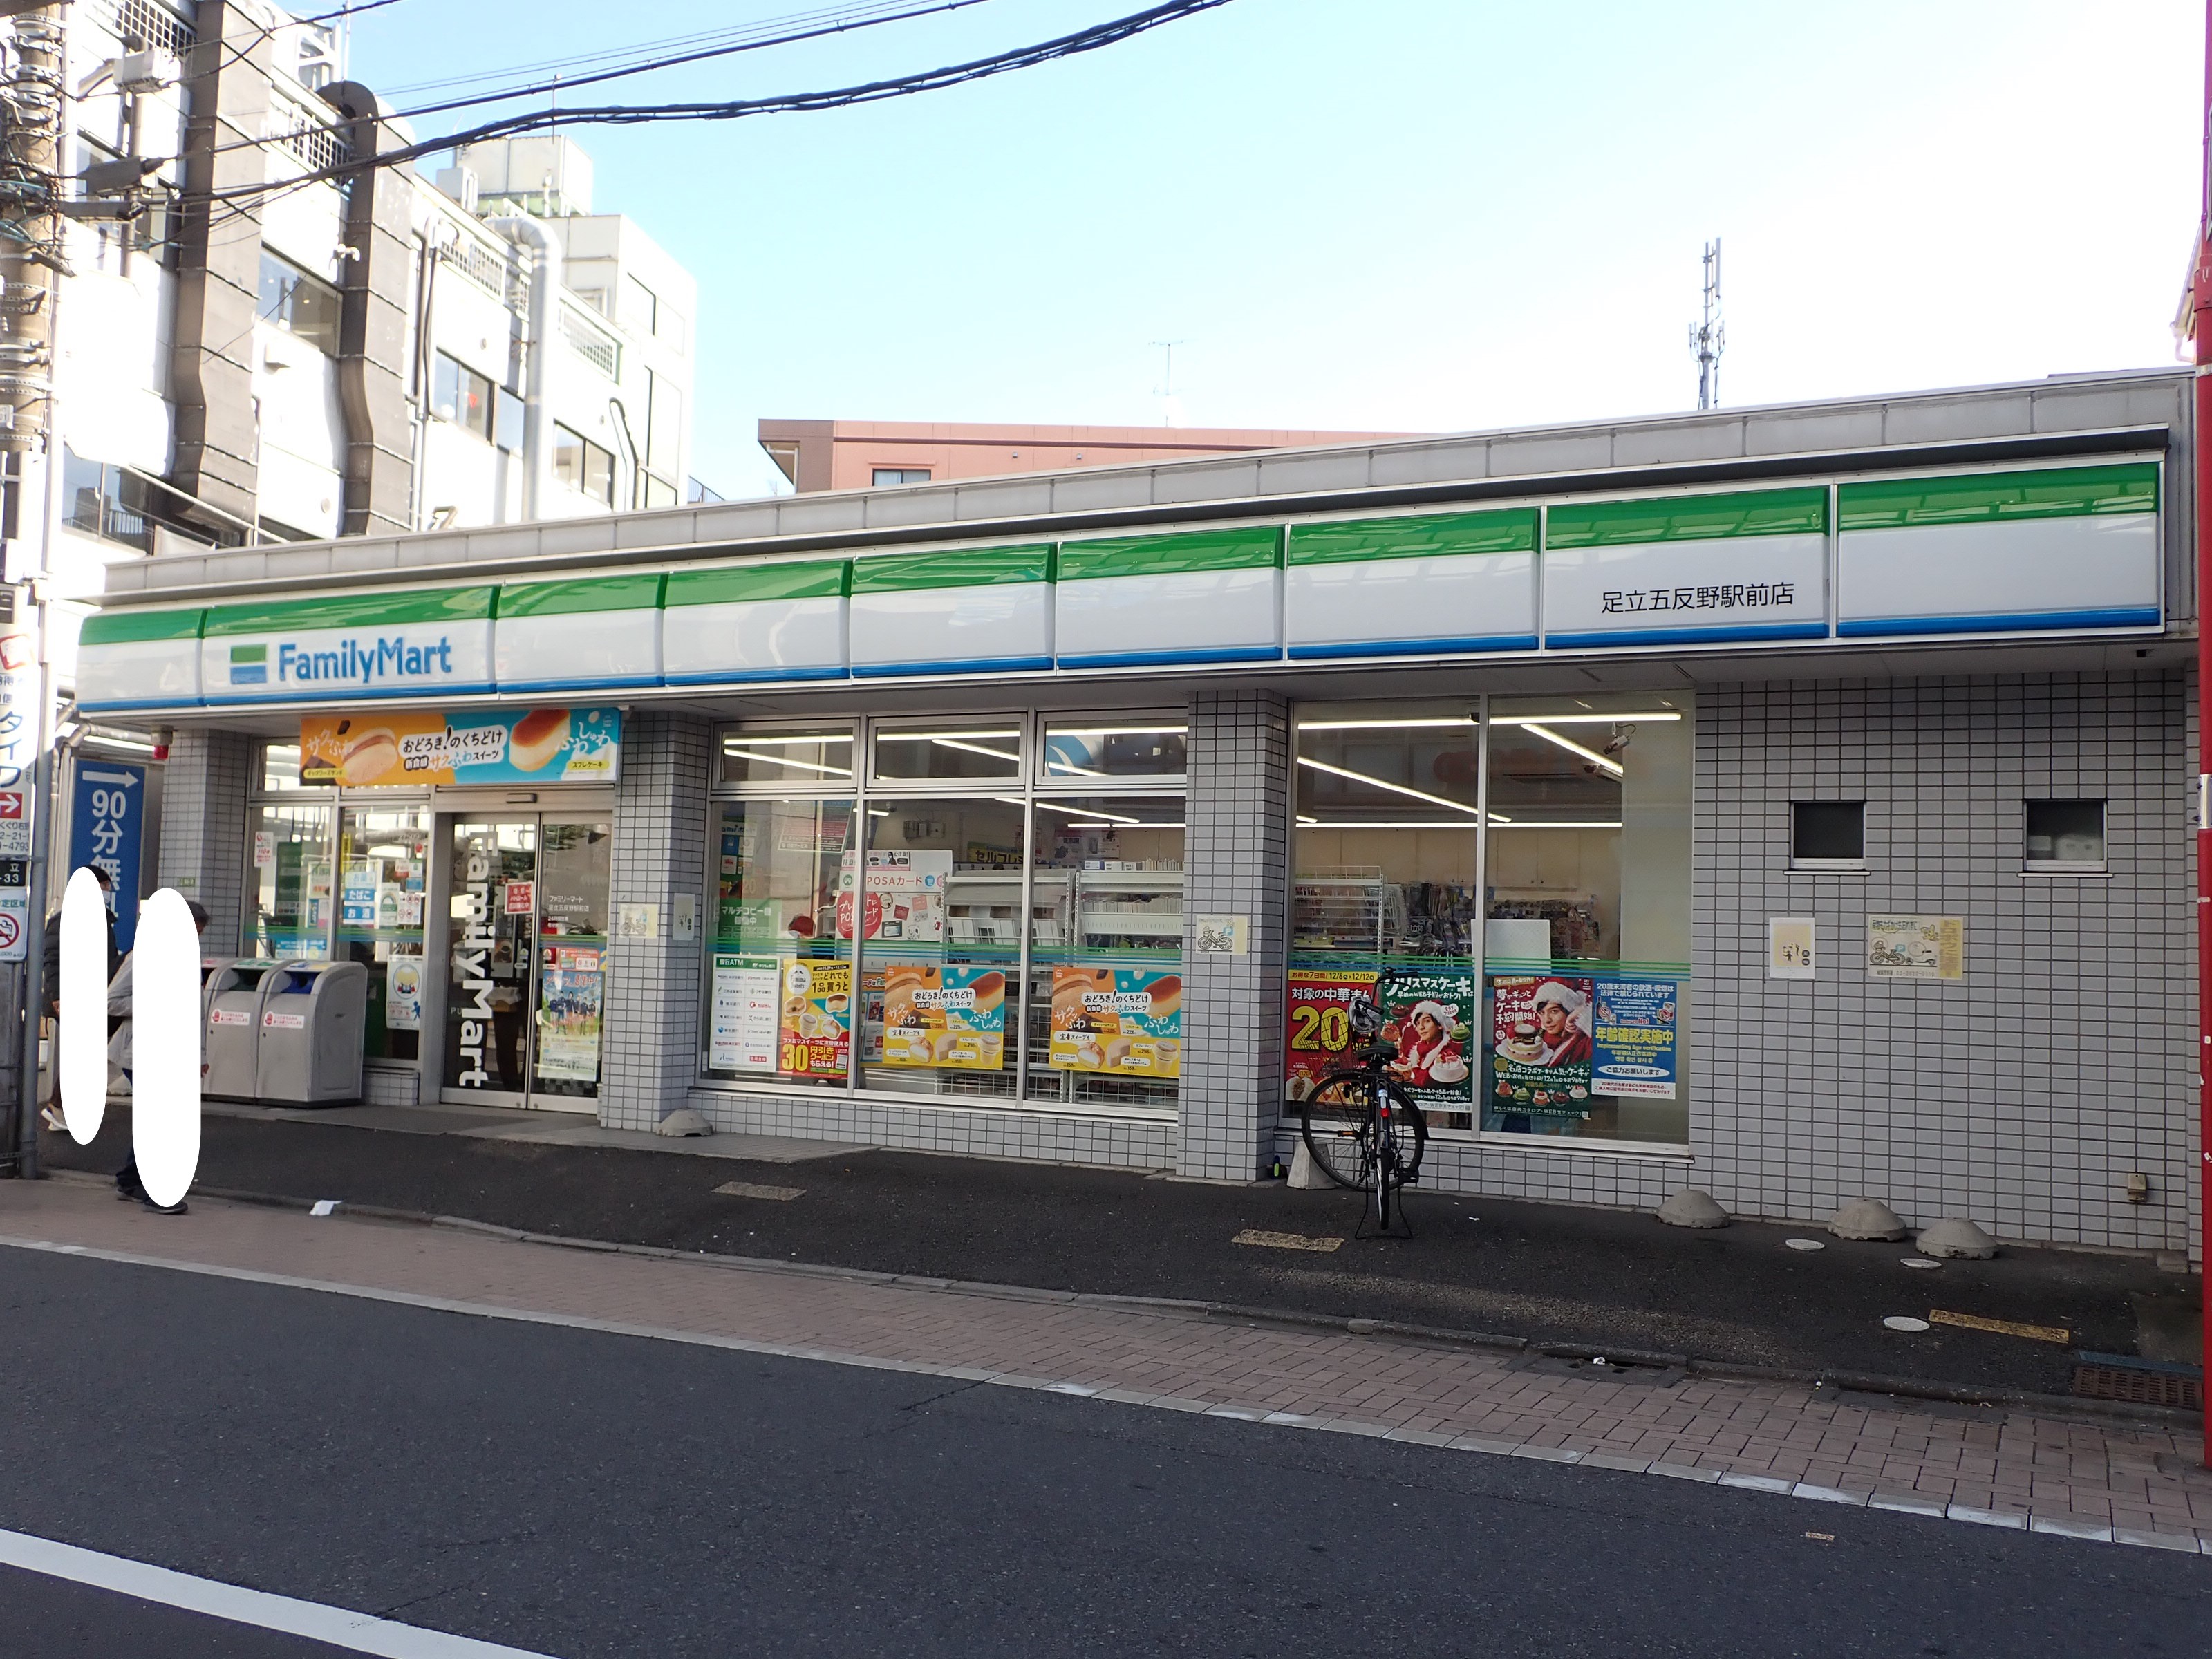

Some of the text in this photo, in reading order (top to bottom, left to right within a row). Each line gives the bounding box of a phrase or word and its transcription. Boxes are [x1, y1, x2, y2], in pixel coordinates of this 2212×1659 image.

[1602, 582, 1794, 614] 足立五反野駅前店
[279, 636, 451, 684] FamilyMart
[403, 726, 503, 753] おどろき!のくちどけ
[91, 789, 126, 926] 90分無
[867, 875, 922, 886] POSAカード
[349, 890, 371, 900] たばこ
[459, 831, 499, 1089] FamilyMart
[824, 971, 849, 980] どれでも
[1291, 971, 1328, 980] お得な7日間!
[812, 981, 849, 993] 1品買うと
[915, 987, 972, 1000] おどろき!のくちどけ
[1085, 990, 1148, 1003] おどろき!のくちどけ
[1496, 988, 1532, 1001] 夢がギュッと
[1496, 1000, 1521, 1013] ケーキ
[1496, 1011, 1535, 1024] 予約開始!
[1291, 1006, 1349, 1051] 20
[1595, 1026, 1674, 1045] 年齢確認実施中
[782, 1043, 809, 1071] 30
[810, 1046, 834, 1055] 円引き
[810, 1060, 834, 1069] もらえる!
[1606, 1067, 1660, 1076] ご協力お願いします
